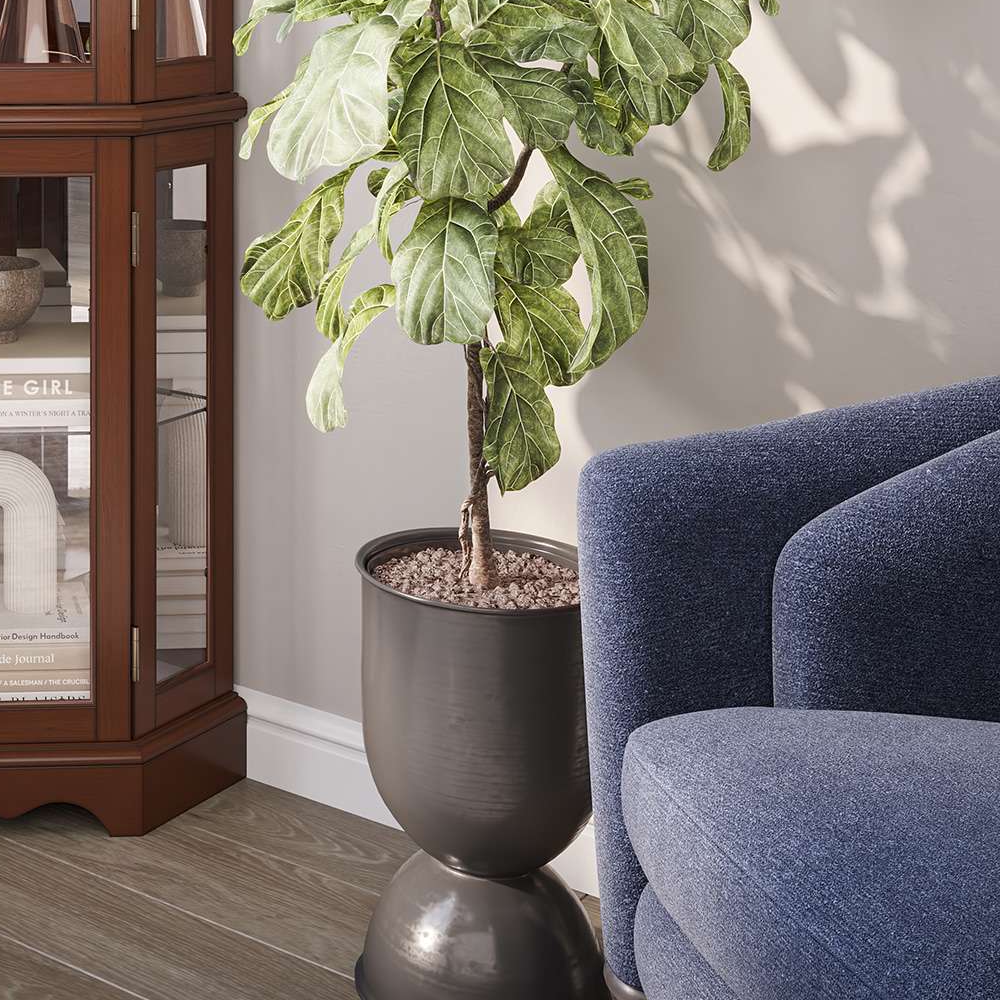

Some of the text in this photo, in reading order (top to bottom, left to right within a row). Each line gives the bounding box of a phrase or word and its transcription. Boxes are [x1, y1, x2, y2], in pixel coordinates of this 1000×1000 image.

[23, 379, 73, 396] GIRL
[49, 409, 70, 417] NIGHT
[11, 632, 38, 642] Design
[39, 632, 80, 640] Handbook
[13, 653, 55, 666] Journal
[9, 679, 43, 687] SALESMAN
